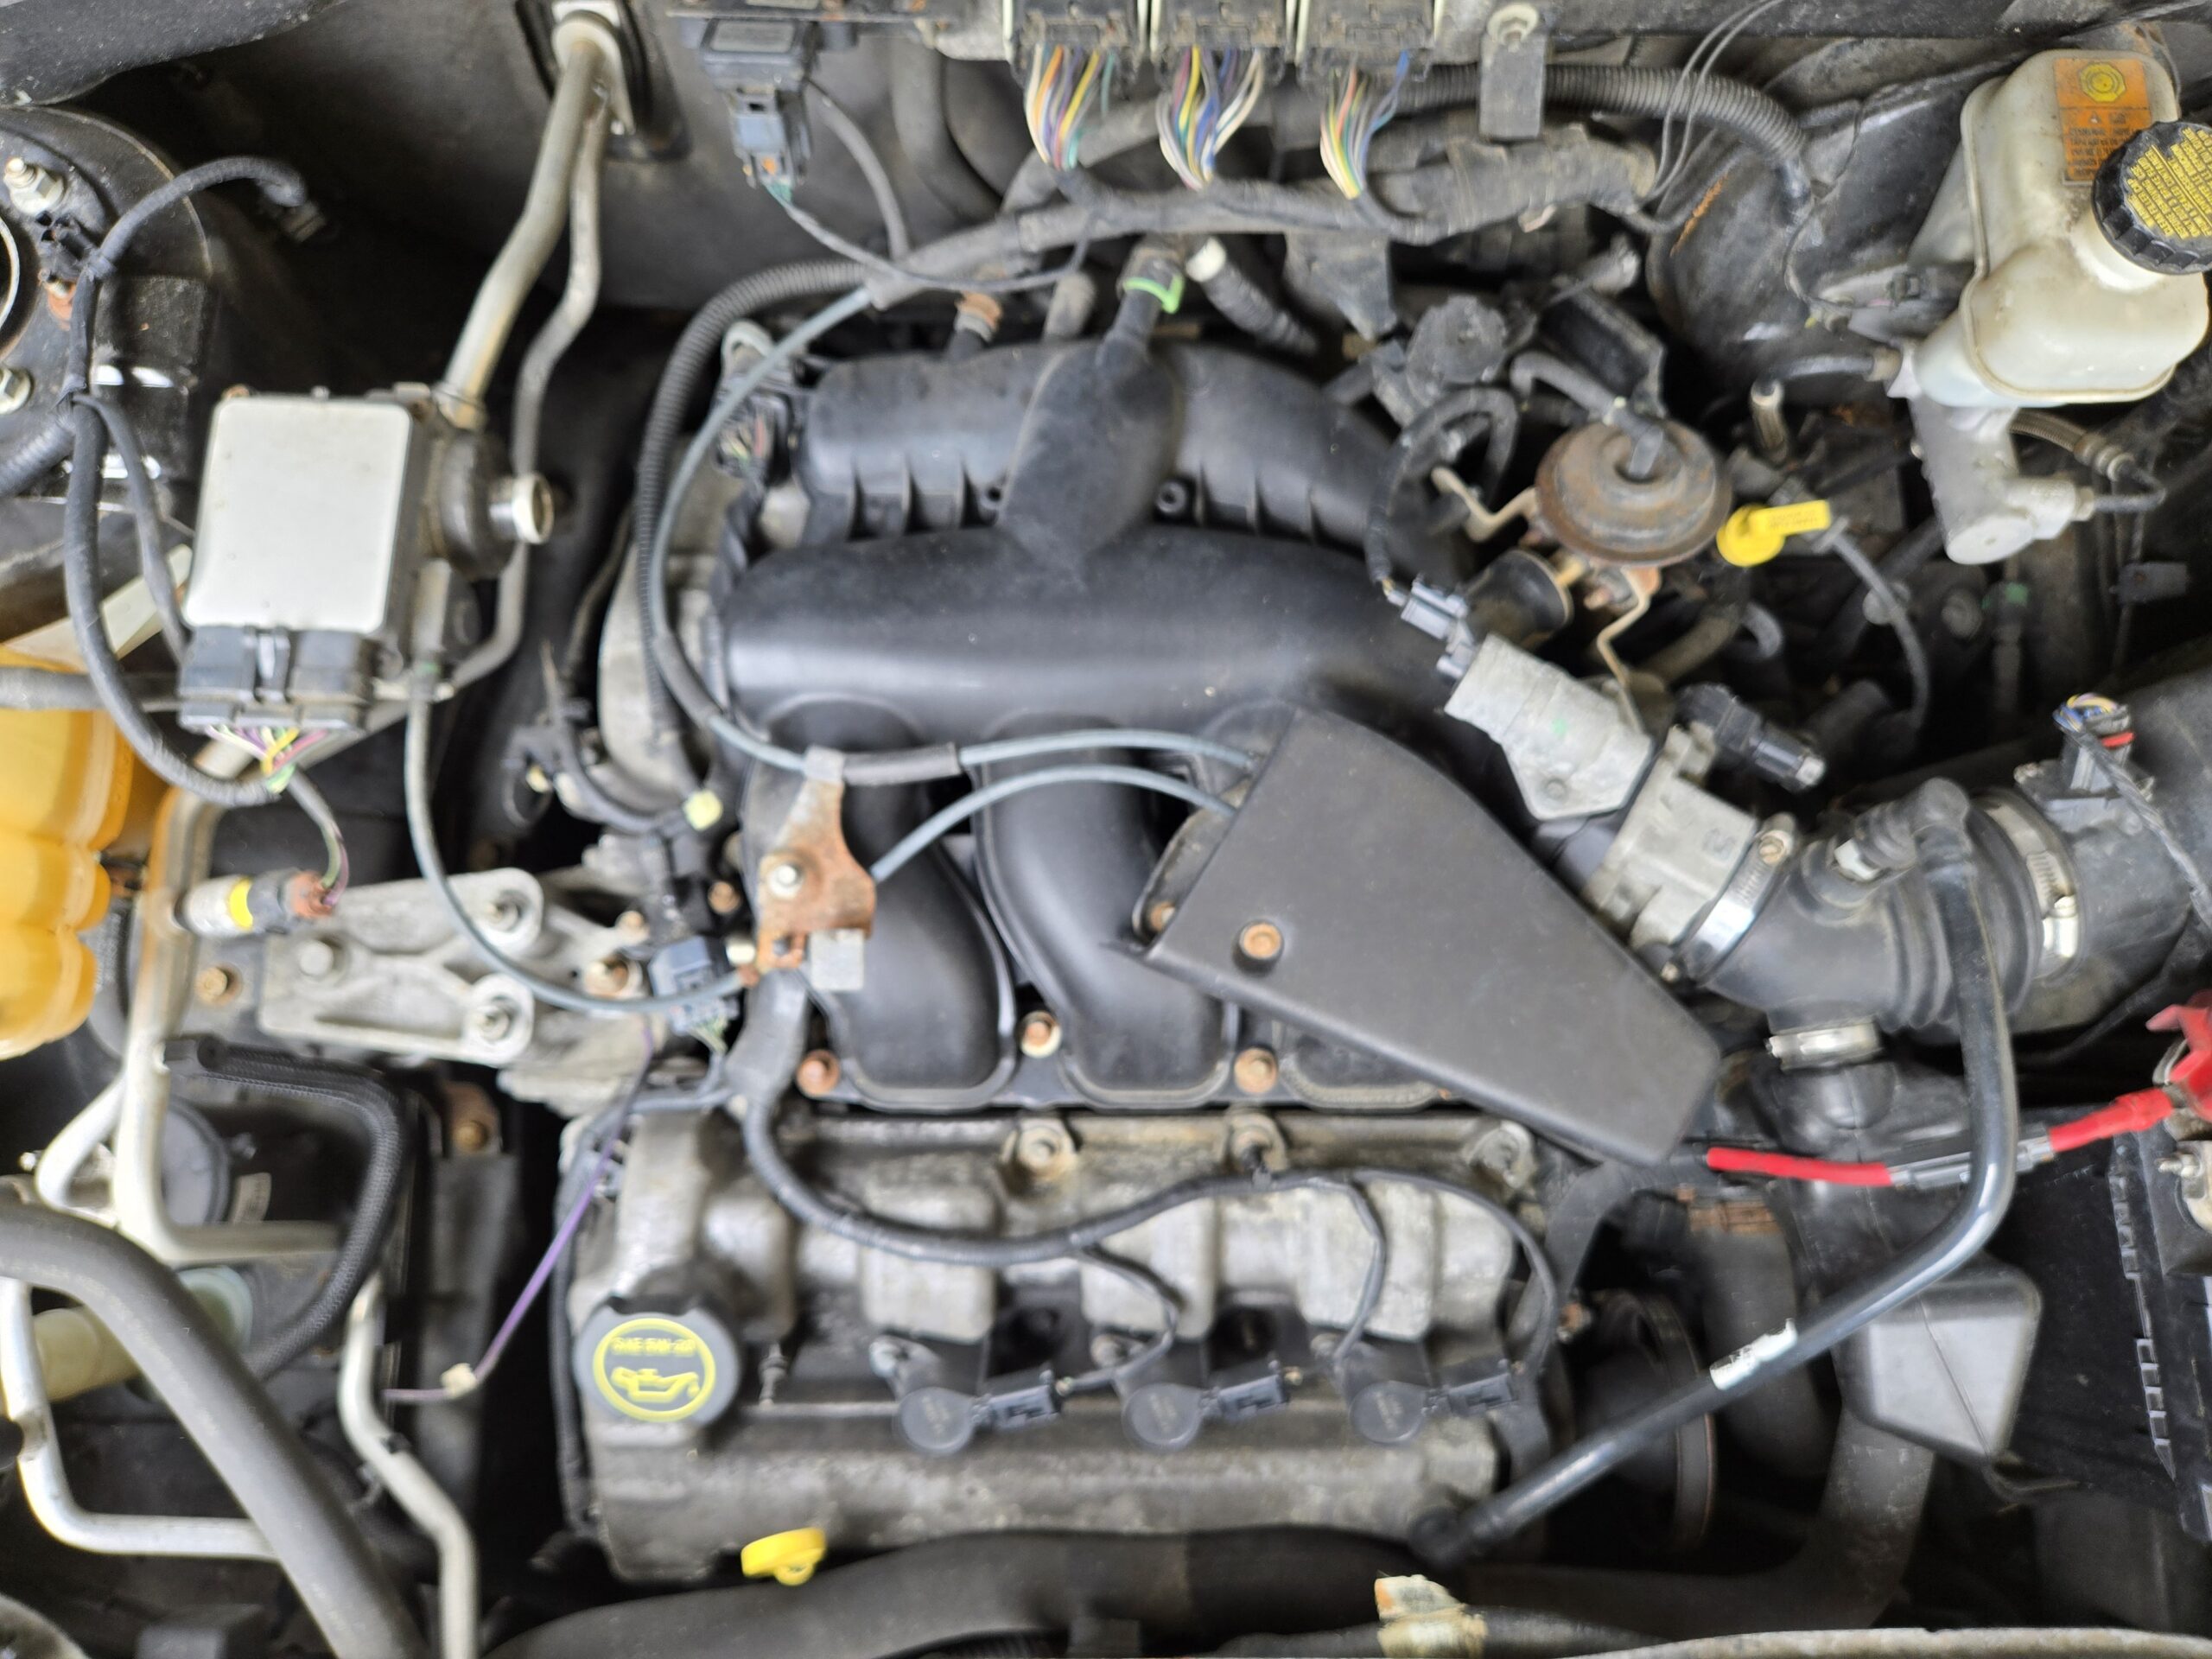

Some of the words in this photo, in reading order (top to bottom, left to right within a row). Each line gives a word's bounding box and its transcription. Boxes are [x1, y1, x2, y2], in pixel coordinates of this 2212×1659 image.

[2131, 163, 2145, 180] USE
[2138, 156, 2154, 176] FLUID
[2127, 176, 2141, 193] CAP
[2151, 175, 2171, 199] BRAKE
[2138, 191, 2157, 214] FILLER
[2171, 185, 2192, 211] SEALED
[2172, 204, 2187, 220] DOT
[2153, 213, 2173, 237] CLEAN
[2165, 211, 2188, 239] BEFORE
[2183, 218, 2200, 238] ONLY
